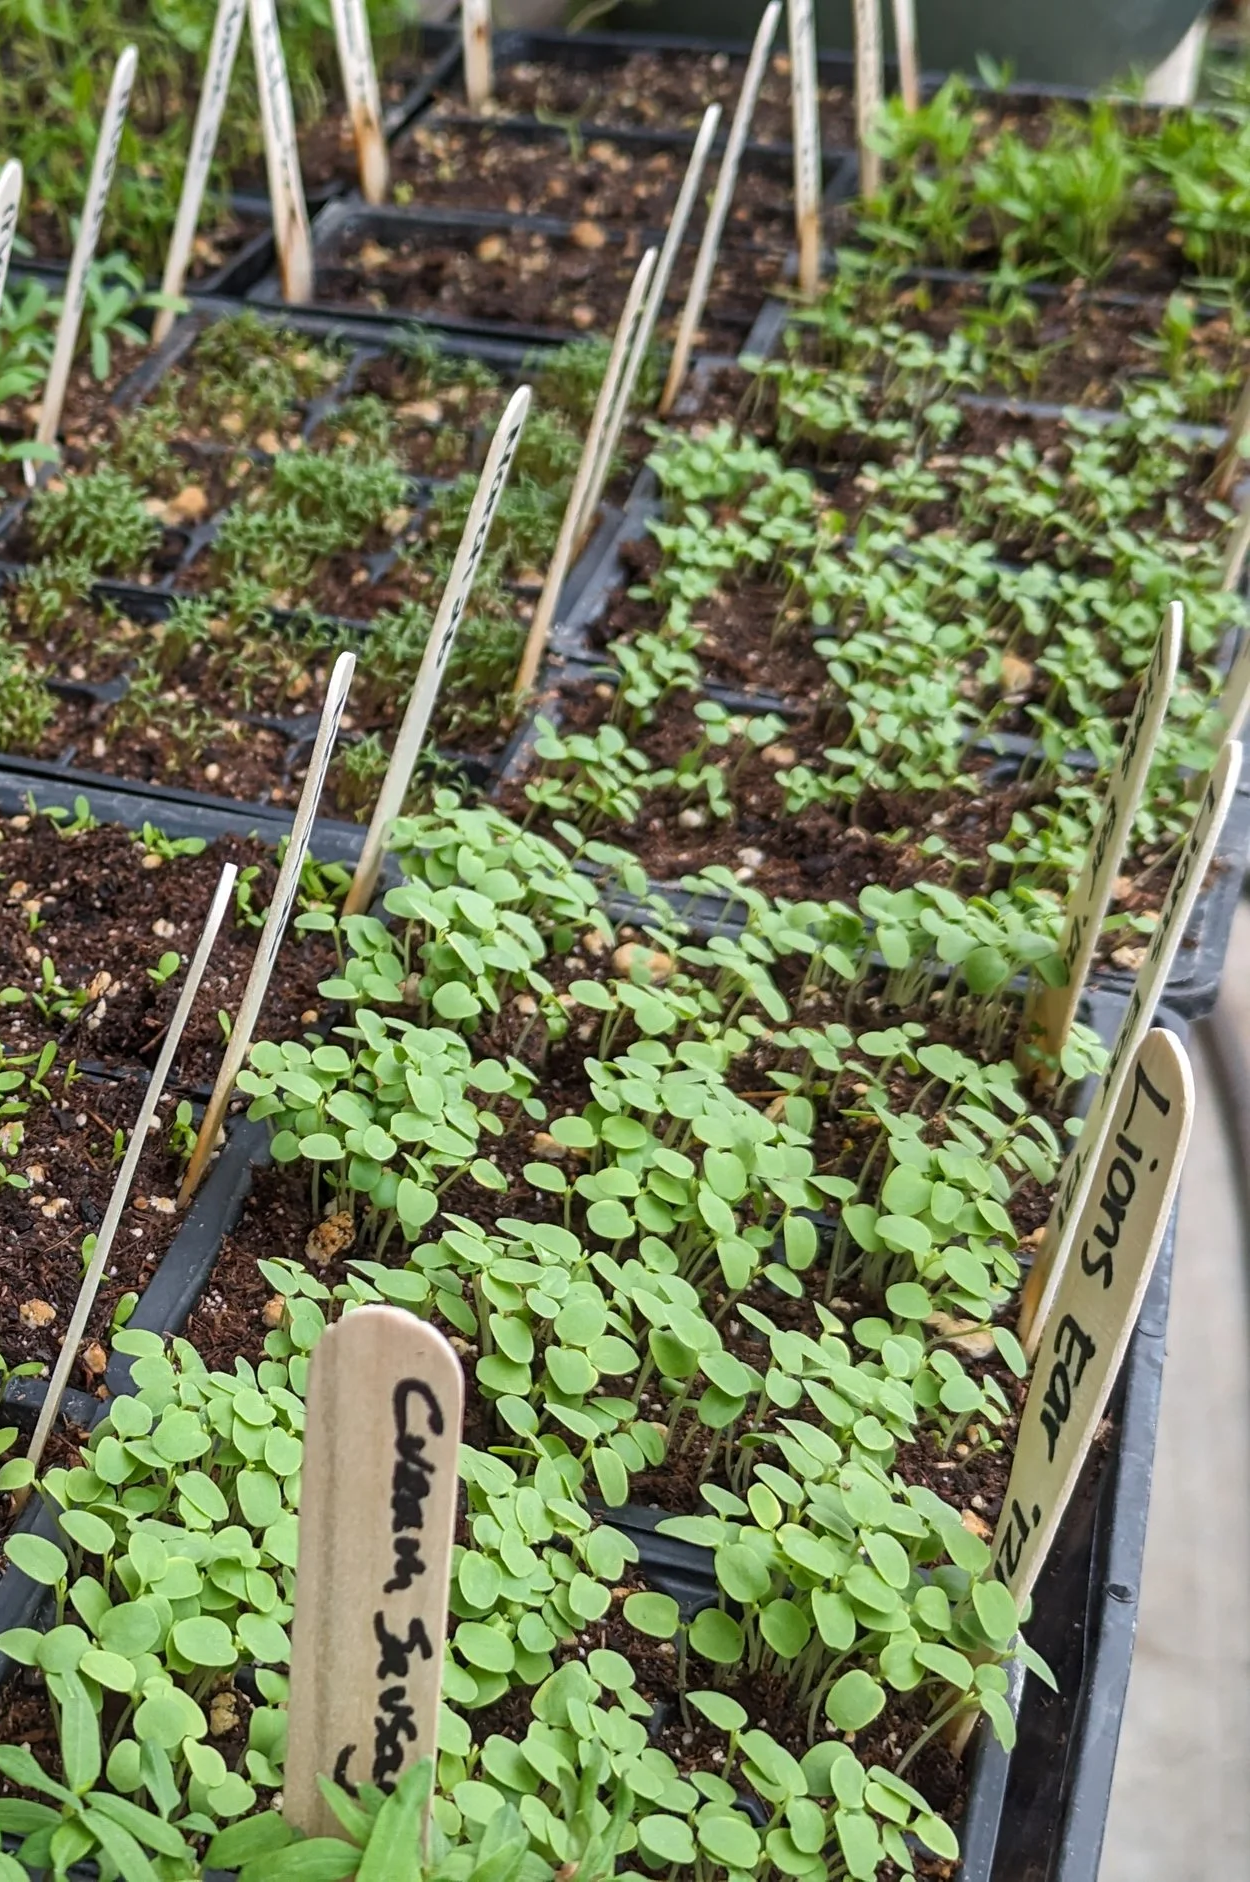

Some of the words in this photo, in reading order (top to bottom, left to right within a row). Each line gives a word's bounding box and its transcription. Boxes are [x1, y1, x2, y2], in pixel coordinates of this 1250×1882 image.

[1150, 782, 1215, 963] Lions
[1082, 1061, 1172, 1289] Lions
[1041, 1313, 1095, 1462] Ear
